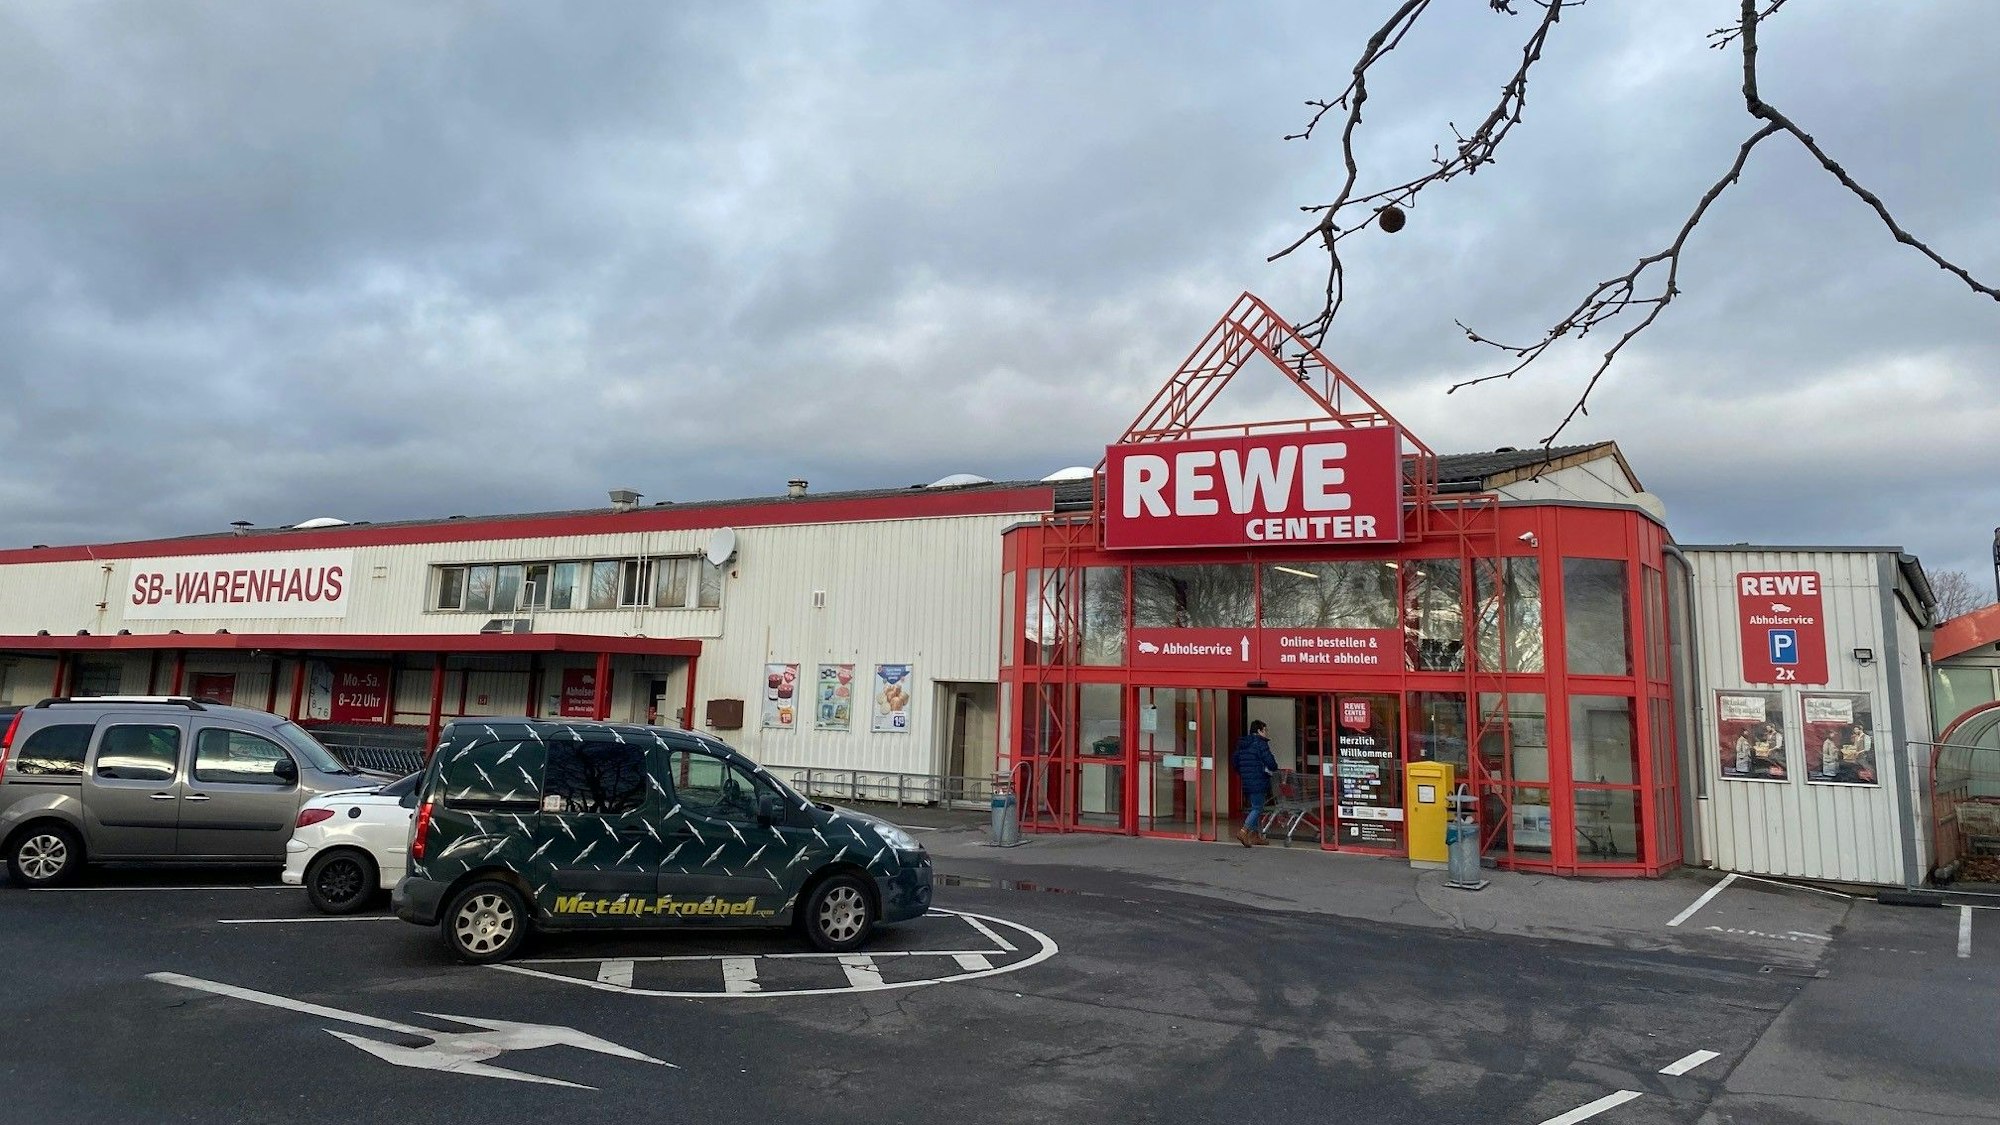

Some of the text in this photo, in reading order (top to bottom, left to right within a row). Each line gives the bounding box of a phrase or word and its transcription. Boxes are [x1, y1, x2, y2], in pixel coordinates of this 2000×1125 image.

[1123, 442, 1351, 518] REWE
[1246, 515, 1376, 541] CENTER
[132, 566, 343, 605] SB-WARENHAUS
[1741, 576, 1817, 596] REWE
[1750, 615, 1814, 625] Abholservice
[1162, 642, 1232, 655] Abholservice
[1280, 636, 1378, 648] Online bestellen &
[1774, 634, 1793, 658] P
[1280, 652, 1378, 664] am Markt abholen
[1775, 667, 1796, 680] 2x
[363, 693, 381, 707] Uhr
[1344, 702, 1366, 710] REWE
[1340, 736, 1375, 745] Herzlich
[1340, 748, 1393, 758] Willkommen
